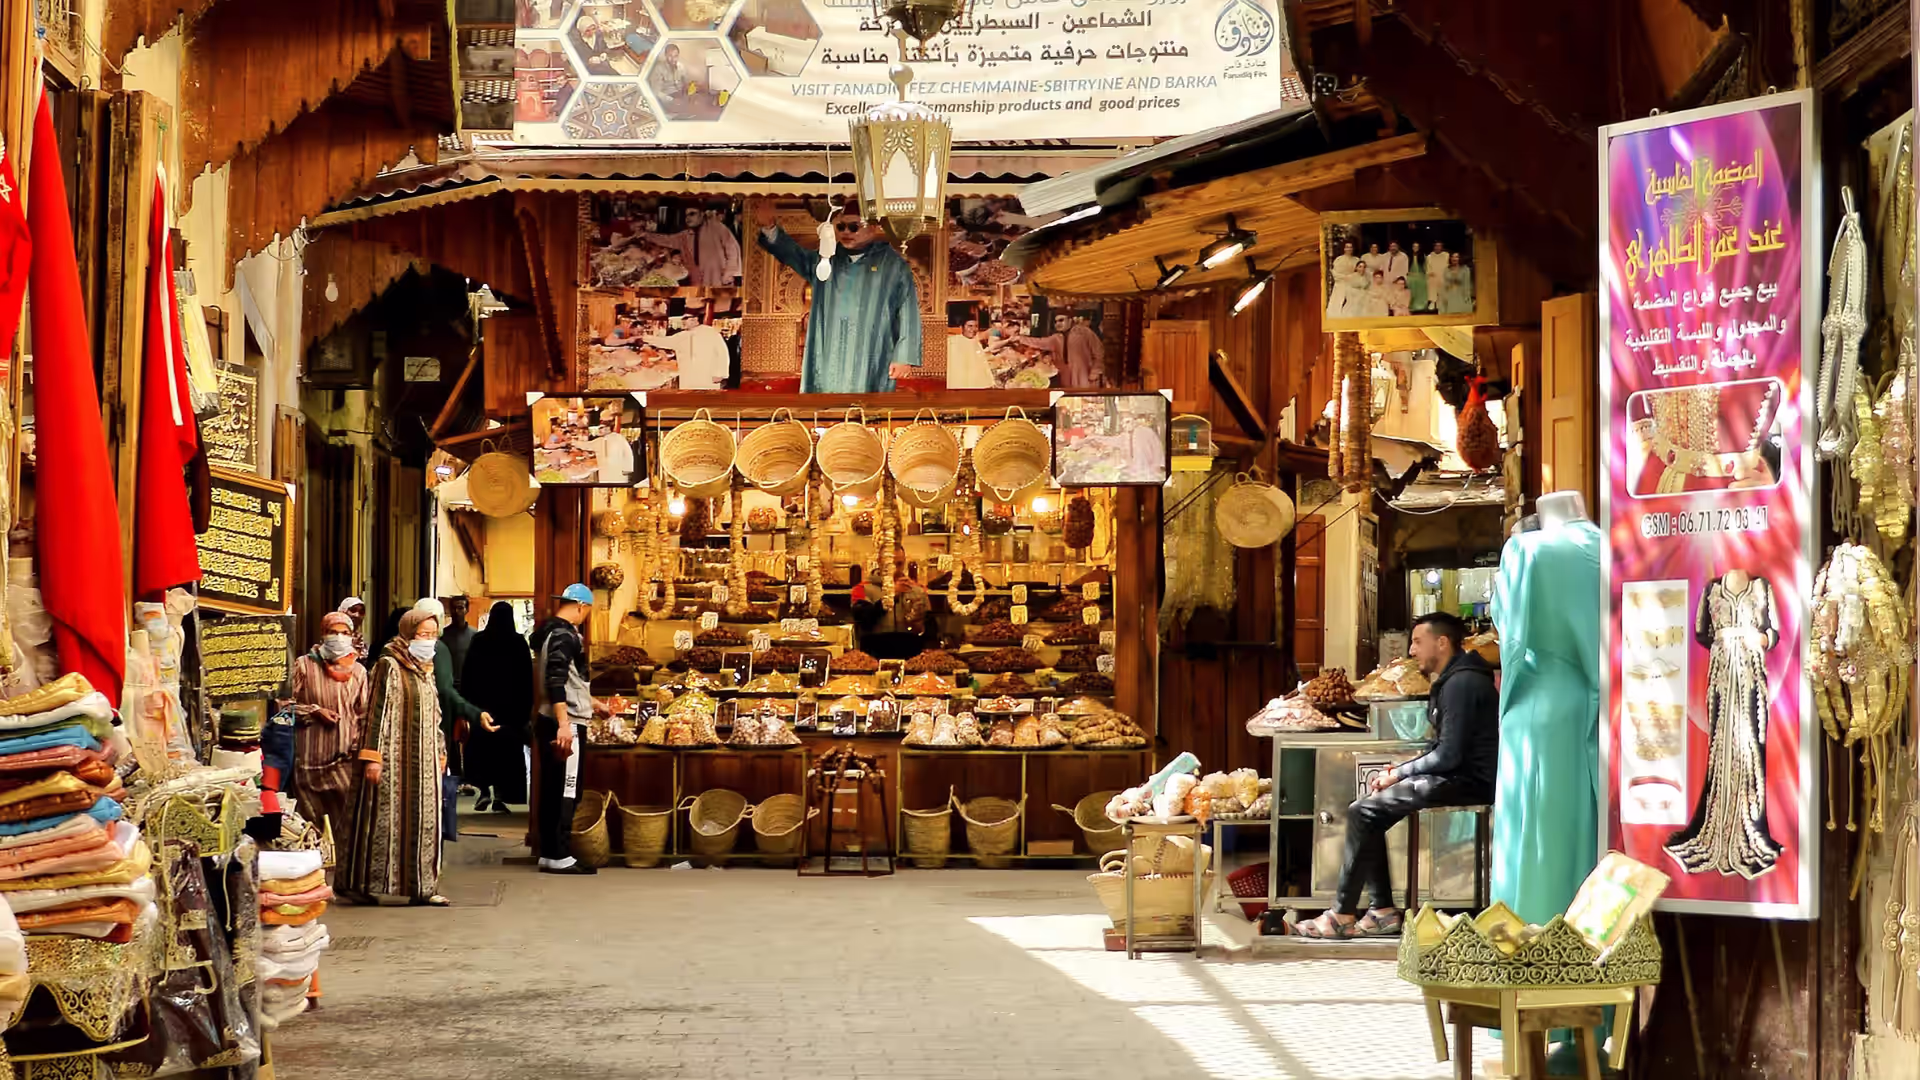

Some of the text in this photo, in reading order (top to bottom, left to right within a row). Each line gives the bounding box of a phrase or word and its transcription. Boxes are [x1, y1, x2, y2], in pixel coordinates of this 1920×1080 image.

[1062, 8, 1152, 33] الشماعين
[821, 48, 888, 69] مناسبة
[968, 45, 1032, 67] متميزة
[1041, 41, 1097, 66] حرفية
[1106, 41, 1188, 63] منتوجات
[791, 83, 829, 96] VISIT
[909, 82, 940, 95] FEZ
[941, 77, 1124, 95] CHEMMAINE-SBITRYINE
[1126, 76, 1161, 90] AND
[1165, 75, 1218, 89] BARKA
[999, 99, 1061, 114] products
[1065, 97, 1092, 111] and
[1099, 97, 1135, 112] good
[1138, 96, 1181, 111] prices
[1746, 219, 1786, 253] عند
[1719, 285, 1753, 308] جميع
[1757, 282, 1778, 303] بيع
